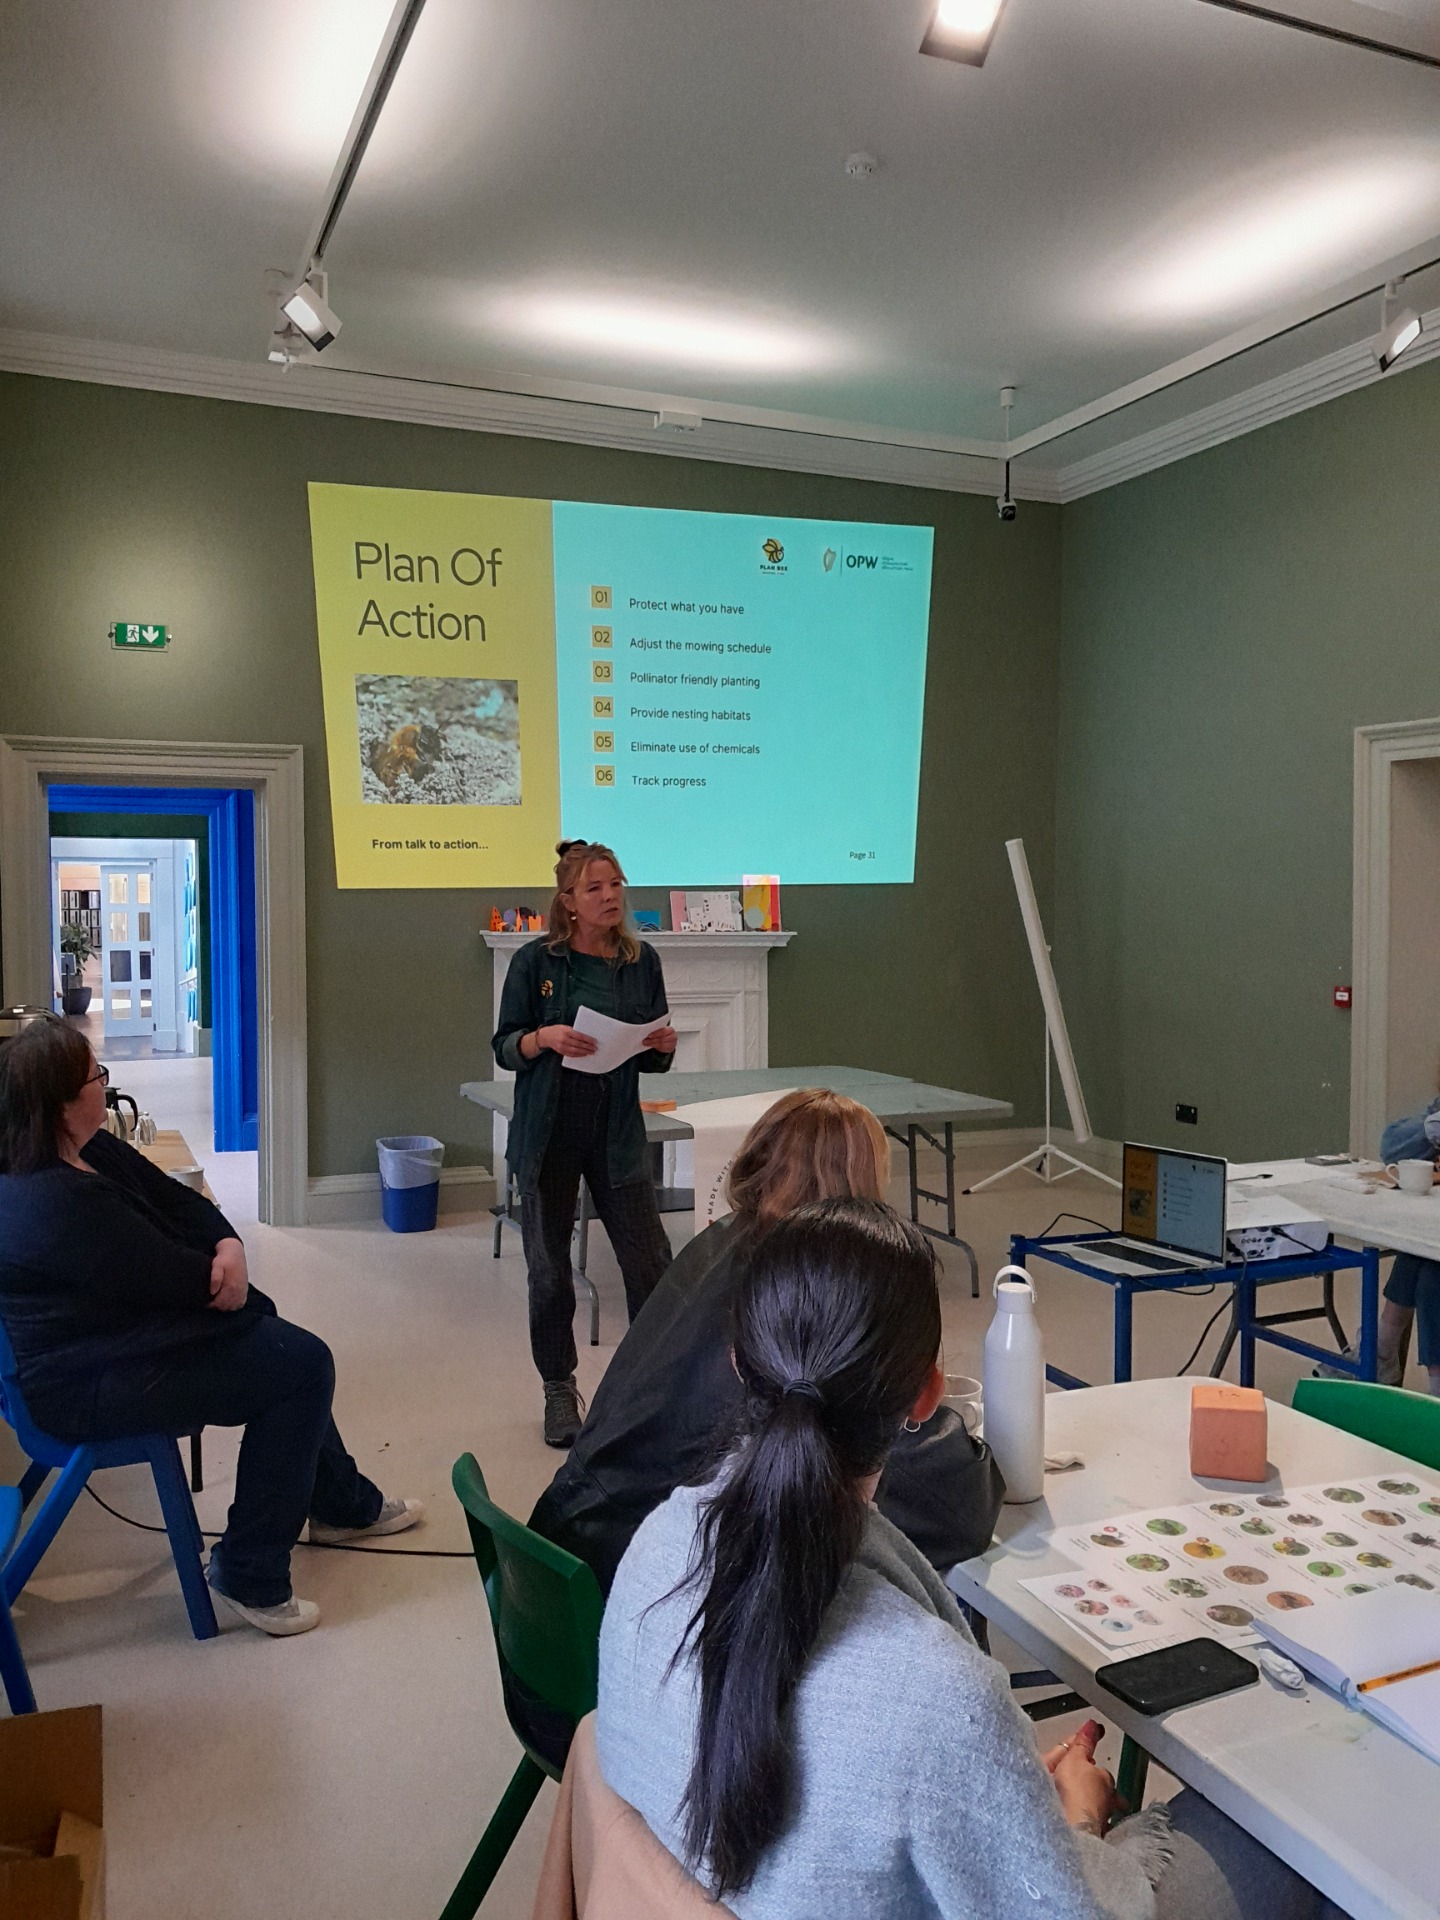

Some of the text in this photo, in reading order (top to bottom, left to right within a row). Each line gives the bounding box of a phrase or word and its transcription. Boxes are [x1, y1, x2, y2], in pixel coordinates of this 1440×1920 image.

[355, 542, 502, 587] Plan Of
[846, 555, 878, 569] OPW
[595, 591, 744, 615] 01 Protect what you have
[358, 600, 486, 641] Action
[594, 631, 771, 654] 02 Adjust the mowing schedule
[595, 666, 760, 689] 03 Pollinator friendly planting
[595, 701, 750, 722] 04 Provide nesting habitats
[596, 736, 760, 754] 05 Eliminate use of chemicals
[597, 770, 706, 788] 06 Track progress
[372, 839, 488, 849] From talk to action...
[849, 851, 876, 861] Page 31
[707, 1187, 719, 1215] MADE
